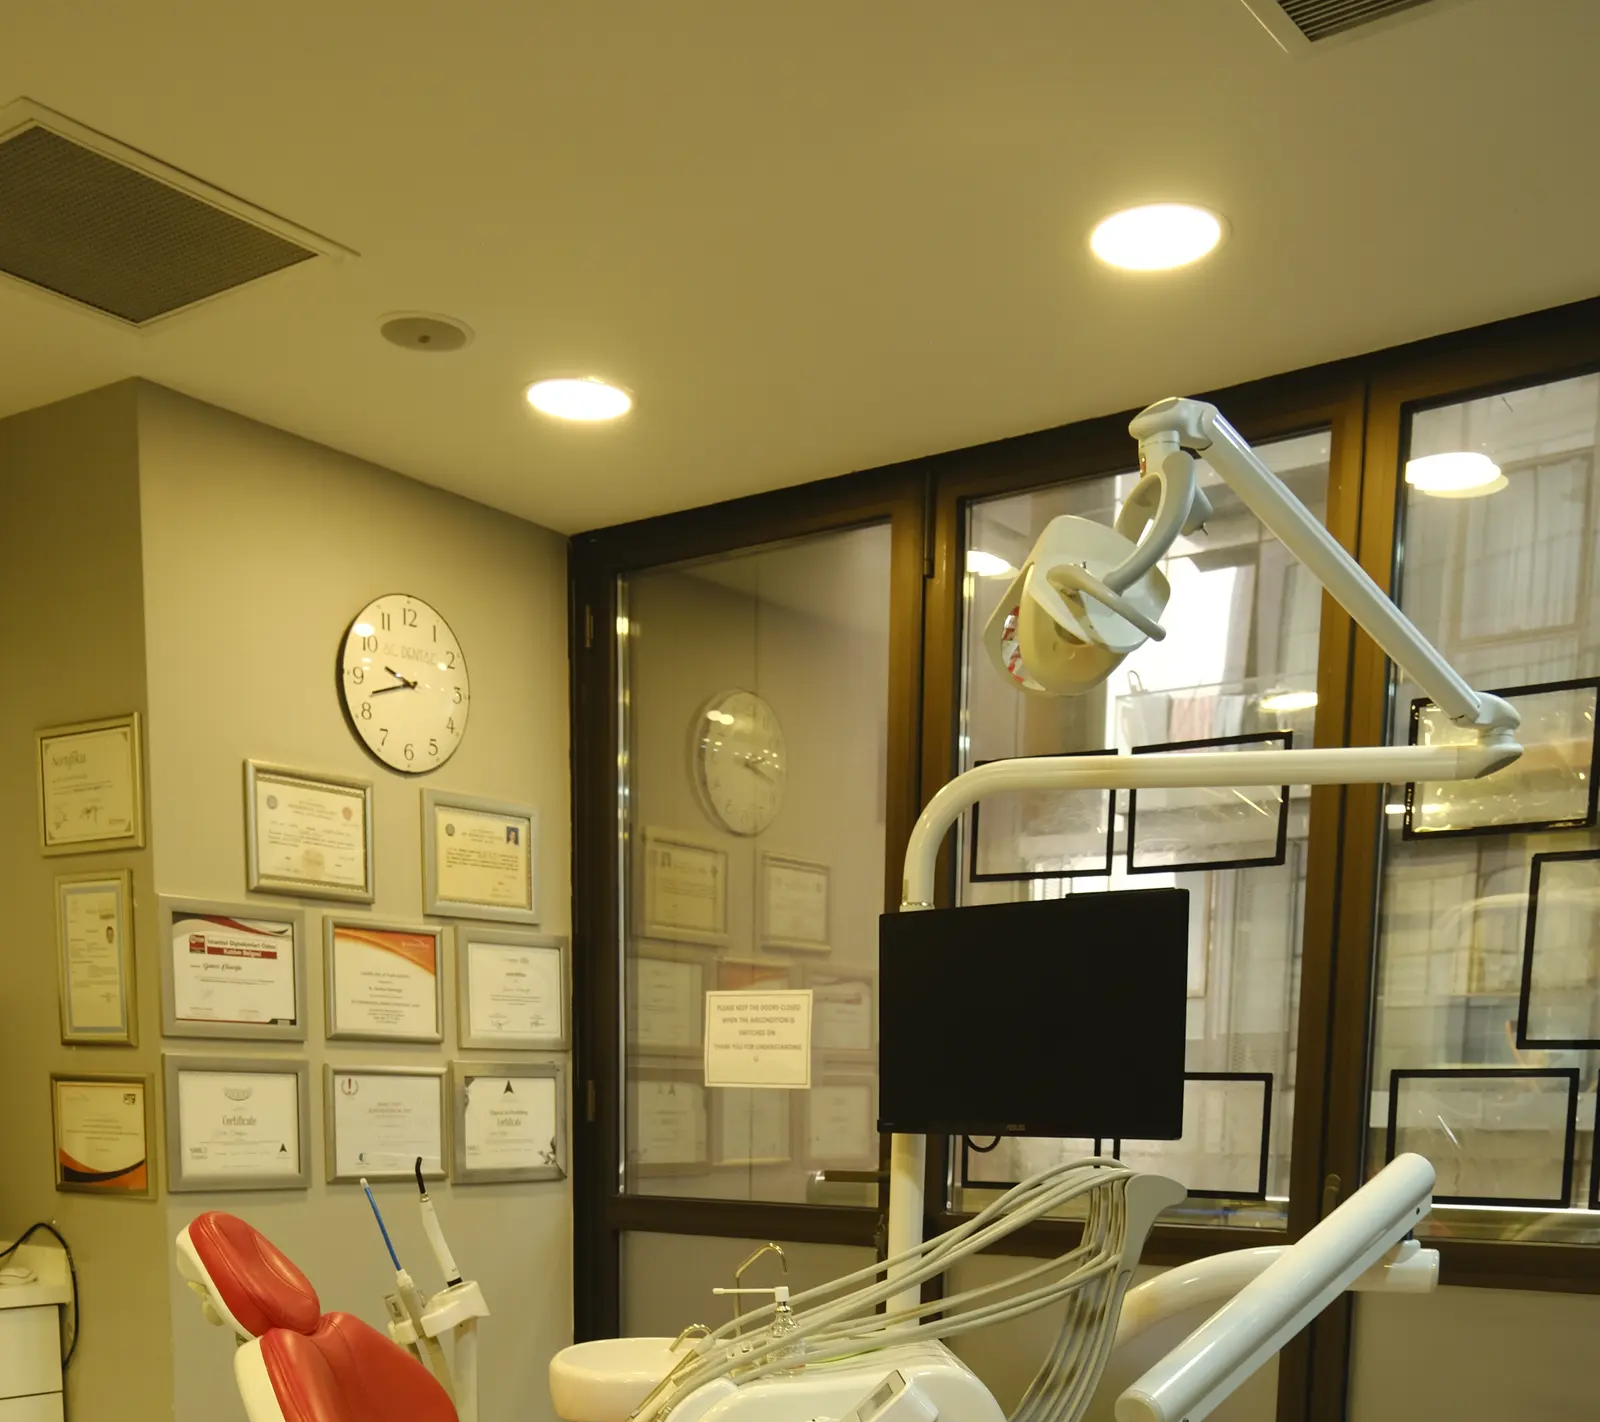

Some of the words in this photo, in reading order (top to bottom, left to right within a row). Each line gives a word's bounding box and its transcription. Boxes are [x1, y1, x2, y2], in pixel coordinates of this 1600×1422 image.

[381, 612, 391, 632] 11
[402, 607, 418, 628] 12
[432, 625, 437, 643] 1
[362, 635, 378, 653] 10
[445, 651, 456, 670] 2
[352, 666, 364, 685] 9
[452, 686, 462, 704] 3
[361, 702, 372, 720] 8
[446, 717, 456, 734] 4
[379, 728, 389, 746] 7
[404, 743, 415, 761] 6
[428, 738, 439, 756] 5
